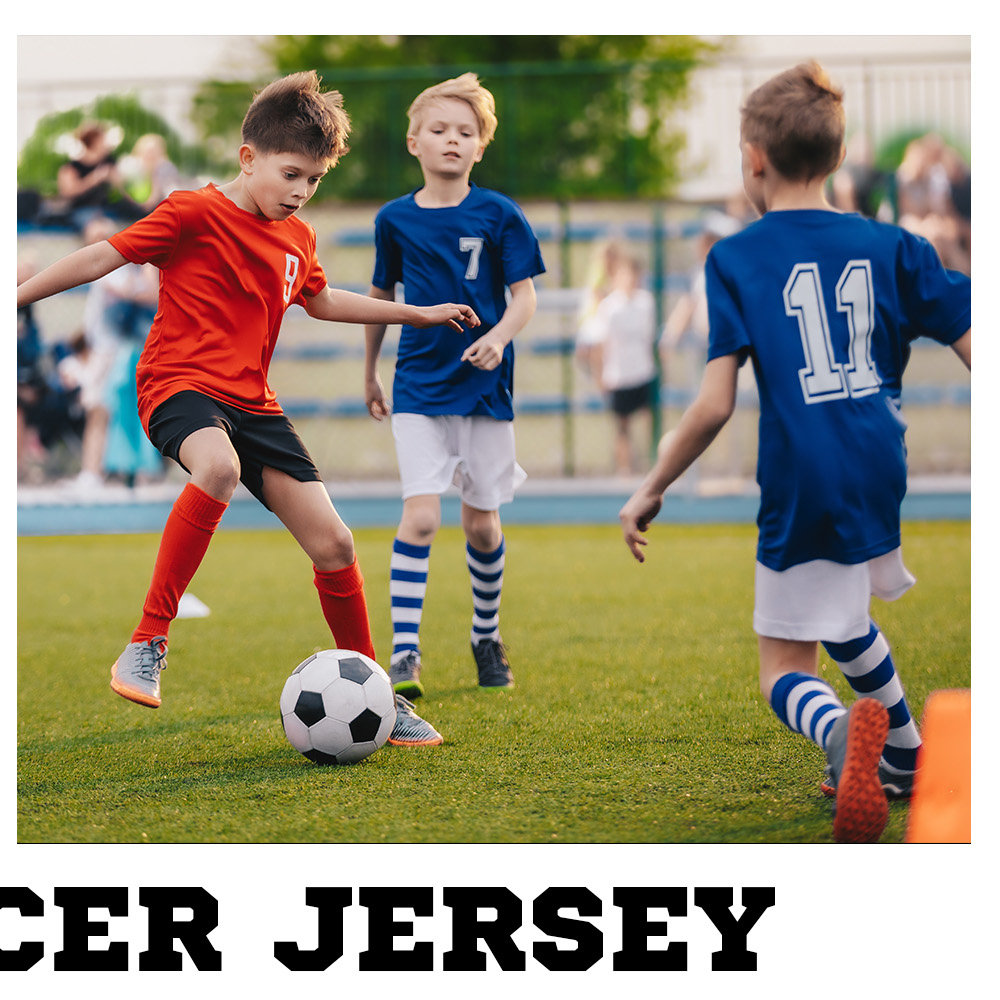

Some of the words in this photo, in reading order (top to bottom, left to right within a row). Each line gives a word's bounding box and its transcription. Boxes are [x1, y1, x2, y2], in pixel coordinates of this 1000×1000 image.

[283, 253, 300, 304] 9
[459, 237, 484, 280] 7
[783, 259, 882, 404] 11
